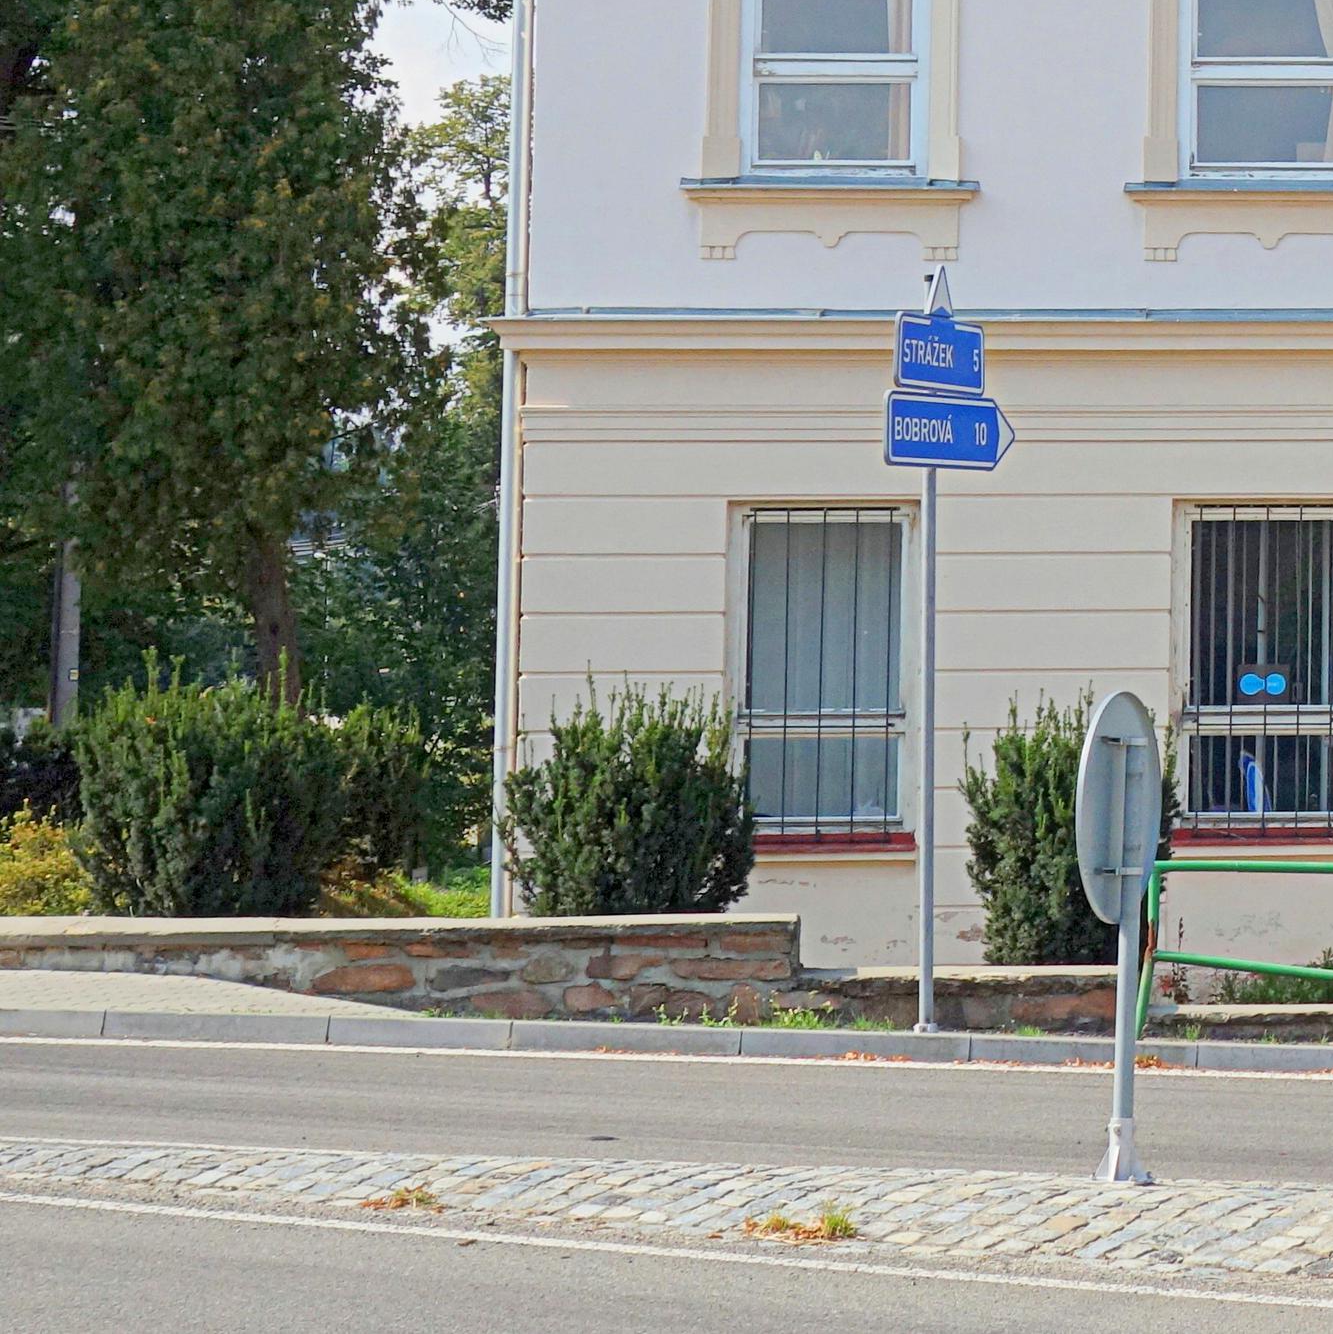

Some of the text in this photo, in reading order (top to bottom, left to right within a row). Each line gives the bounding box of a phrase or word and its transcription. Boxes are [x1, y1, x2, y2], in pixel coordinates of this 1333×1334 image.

[903, 335, 980, 372] STRÁŽEK 5
[894, 414, 988, 446] BOBROVÁ 10
